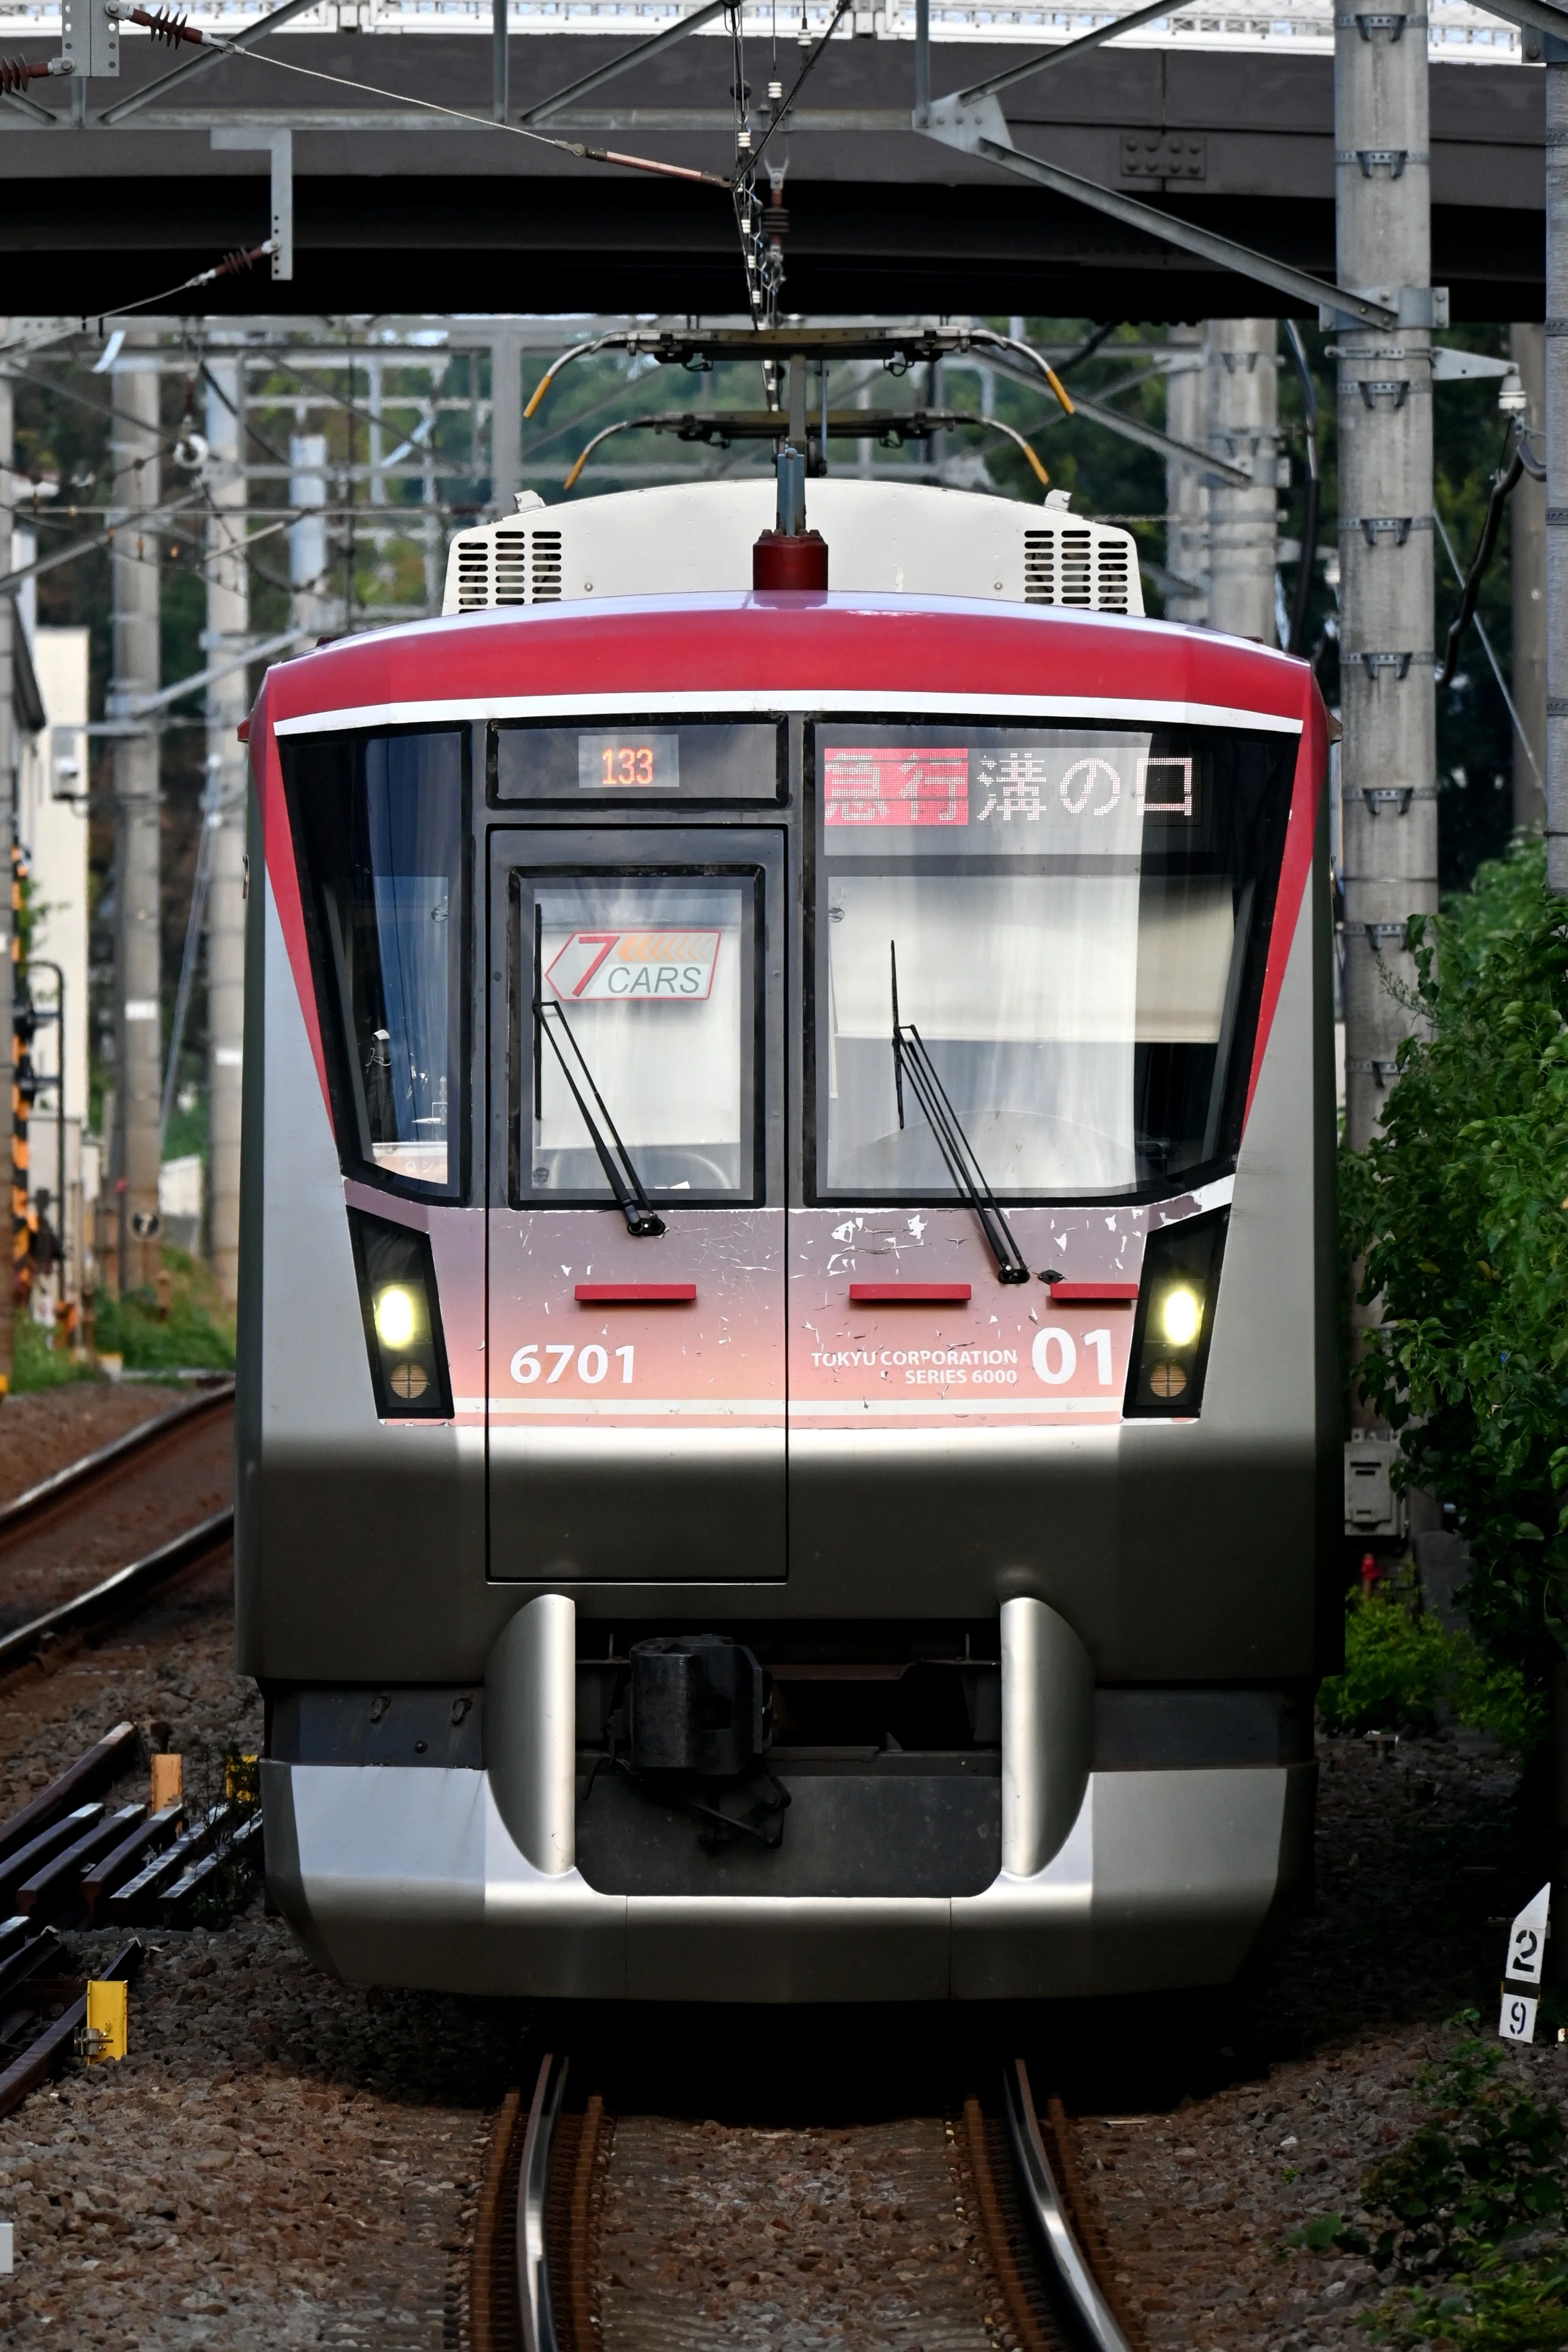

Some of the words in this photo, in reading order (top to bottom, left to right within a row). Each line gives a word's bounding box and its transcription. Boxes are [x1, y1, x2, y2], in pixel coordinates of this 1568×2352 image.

[602, 748, 654, 785] 133
[825, 753, 966, 821] 急行
[976, 753, 1192, 821] 溝の口
[572, 936, 620, 997] 7
[608, 966, 701, 993] CARS
[510, 1344, 634, 1384] 6701
[811, 1351, 877, 1368] TOKYU
[880, 1350, 1018, 1366] CORPORATION
[1032, 1327, 1113, 1386] 01
[905, 1370, 967, 1384] SERIES
[971, 1370, 1018, 1384] 6000
[1512, 1929, 1538, 1973] 2
[1510, 2002, 1526, 2035] 9
